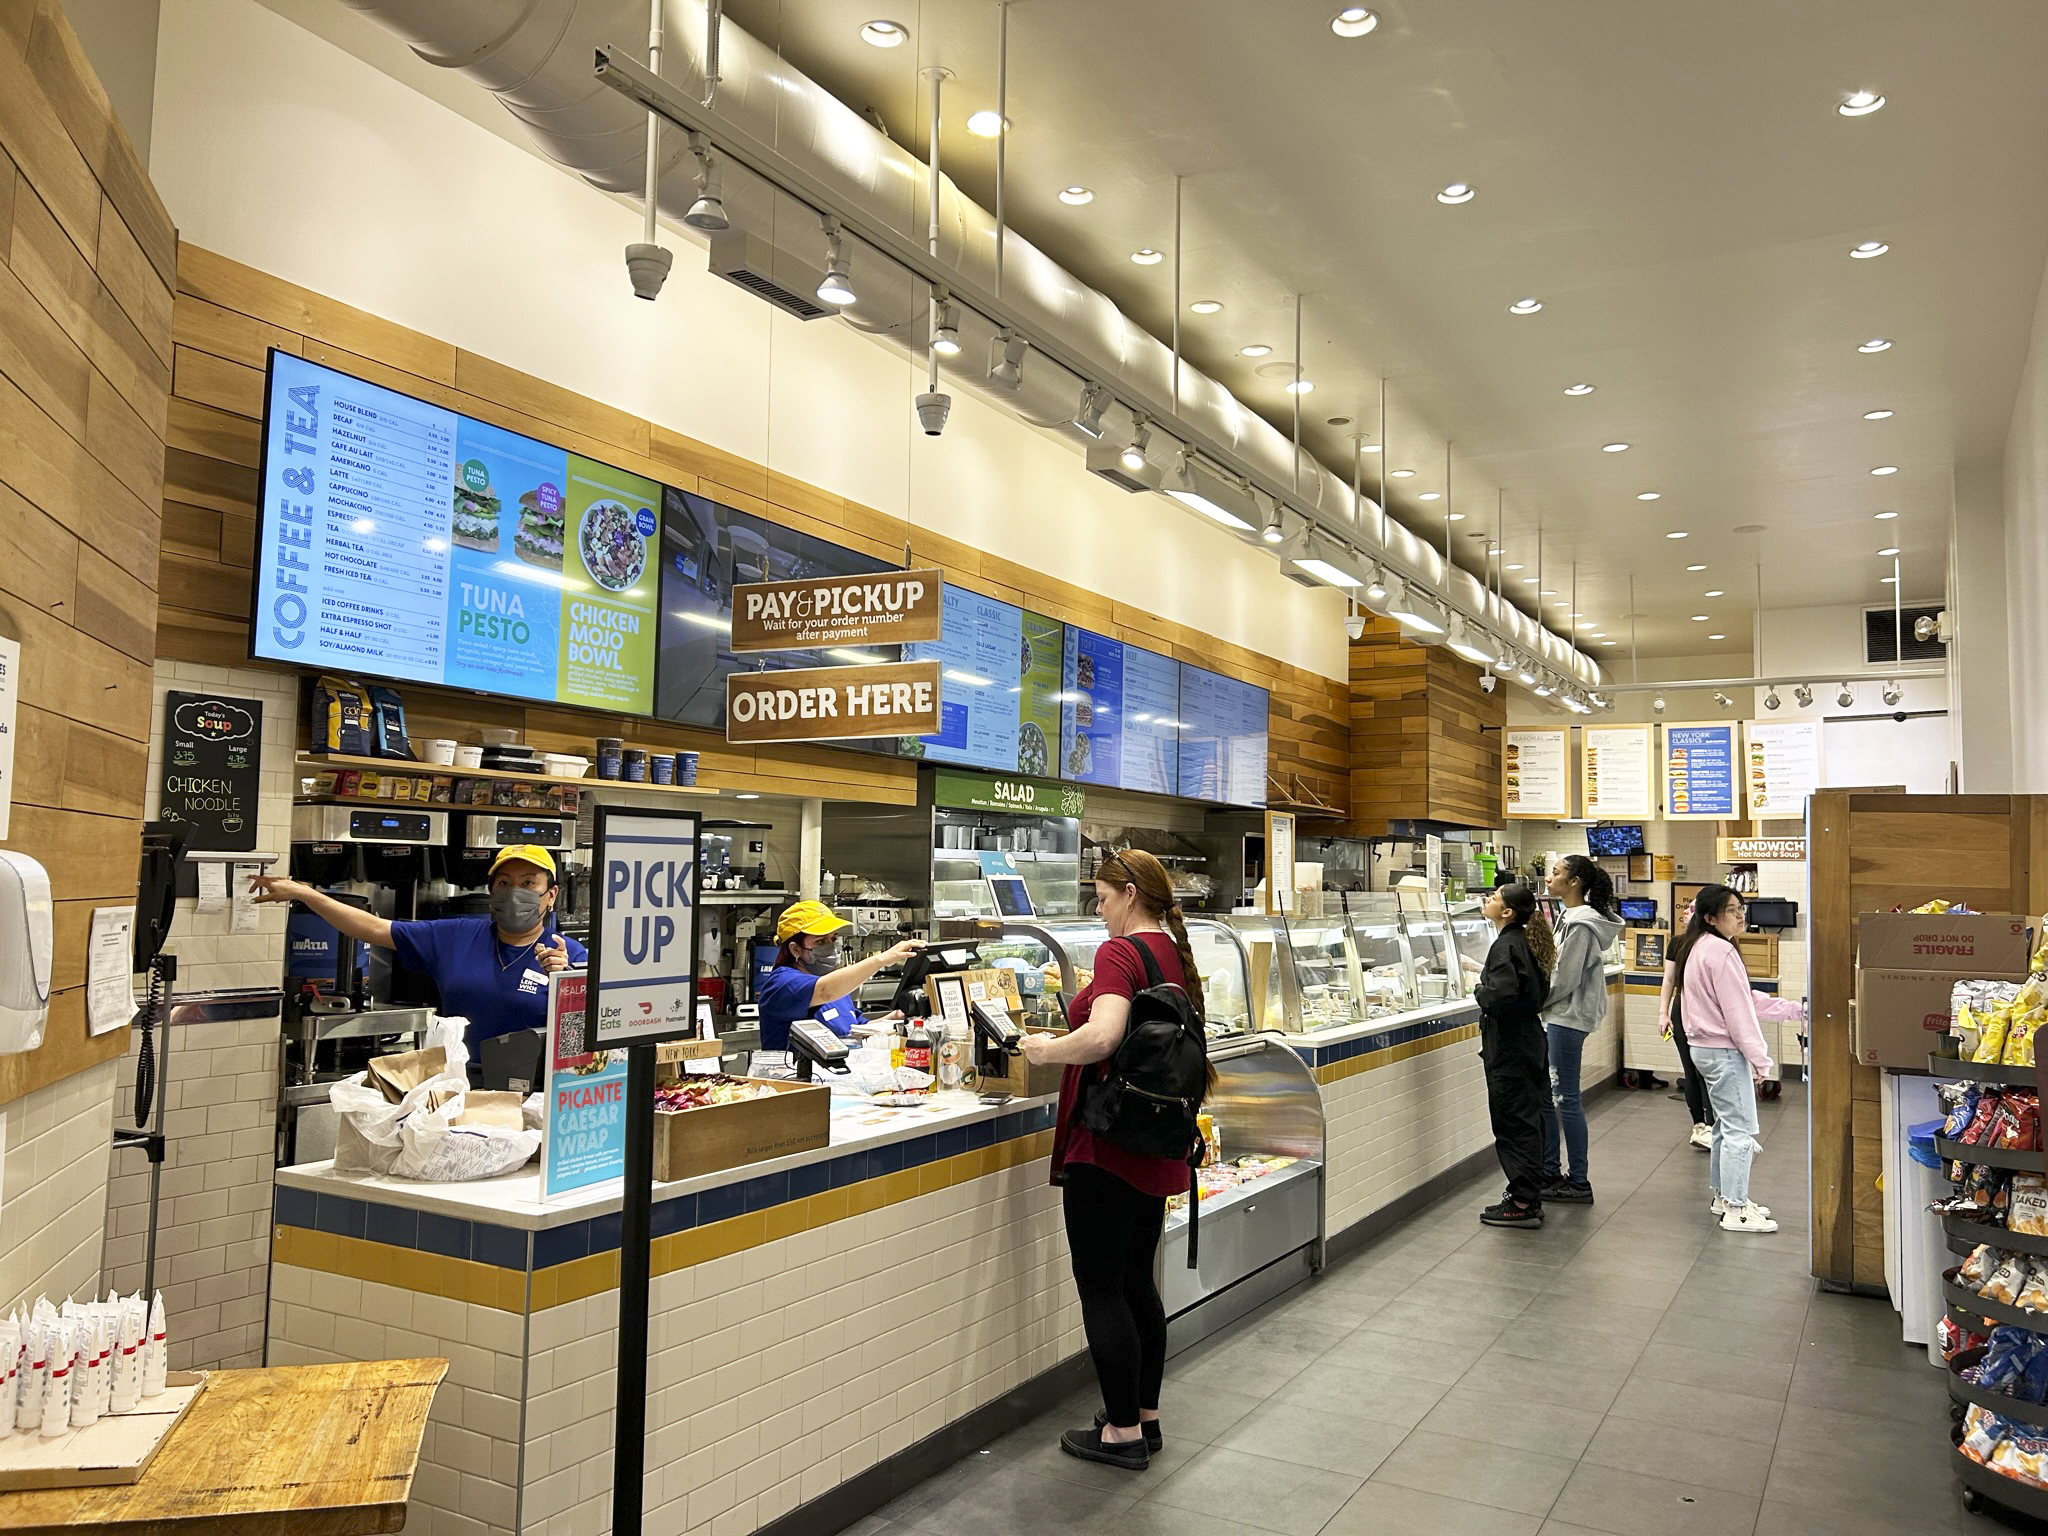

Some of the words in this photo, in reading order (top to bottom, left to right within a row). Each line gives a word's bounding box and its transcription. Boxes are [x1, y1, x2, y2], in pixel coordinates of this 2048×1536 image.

[333, 400, 356, 413] HOUSE
[357, 408, 377, 419] BLEND
[284, 385, 320, 455] TEA
[333, 413, 353, 424] DECAF
[332, 427, 366, 443] HAZELNUT
[331, 441, 347, 451] CAFE
[348, 446, 358, 454] AU
[360, 449, 373, 458] LAIT
[330, 455, 370, 472] AMERICANO
[467, 466, 485, 478] TUNA
[282, 466, 315, 495] &
[329, 468, 349, 479] LATTE
[466, 474, 486, 486] PESTO
[329, 482, 369, 498] CAPPUCCINO
[541, 486, 557, 496] SPICY
[541, 493, 557, 503] TUNA
[328, 496, 372, 513] MOCHACCINO
[540, 500, 557, 511] PESTO
[327, 509, 359, 523] ESPRESSO
[638, 514, 654, 524] GRAIN
[326, 523, 339, 532] TEA
[638, 521, 654, 531] BOWL
[325, 537, 351, 549] HERBAL
[352, 543, 364, 552] TEA
[324, 551, 340, 560] HOT
[340, 554, 377, 569] CHOCOLATE
[273, 499, 313, 649] COFFEE
[324, 564, 344, 575] FRESH
[345, 569, 359, 578] ICED
[360, 572, 372, 581] TEA
[321, 597, 336, 606] ICED
[336, 600, 360, 611] COFFEE
[361, 605, 384, 616] DRINKS
[460, 582, 525, 619] TUNA
[747, 591, 796, 620] PAY
[796, 590, 814, 617] &
[814, 581, 924, 616] PICKUP
[321, 611, 342, 622] EXTRA
[342, 616, 374, 627] ESPRESSO
[375, 621, 392, 631] SHOT
[570, 602, 639, 635] CHICKEN
[763, 618, 786, 631] Wait
[788, 618, 802, 629] for
[804, 618, 829, 631] your
[830, 614, 860, 627] order
[861, 612, 904, 625] number
[976, 605, 1001, 622] CLASSIC
[320, 626, 338, 635] HALF
[344, 630, 362, 639] HALF
[459, 609, 530, 644] PESTO
[796, 628, 820, 641] after
[822, 627, 868, 642] payment
[569, 622, 624, 651] MOJO
[319, 640, 365, 654] SOY/ALMOND
[366, 648, 384, 657] MILK
[568, 642, 623, 671] BOWL
[1062, 626, 1076, 751] SANWICH
[732, 687, 838, 723] ORDER
[846, 681, 933, 717] HERE
[204, 710, 226, 719] Today's
[196, 716, 232, 733] Soup
[175, 740, 194, 749] Small
[228, 744, 248, 754] Large
[167, 775, 232, 795] CHICKEN
[994, 780, 1035, 803] SALAD
[184, 797, 241, 811] NOODLE
[1732, 841, 1805, 852] SANDWICH
[1780, 851, 1800, 859] Soup
[607, 860, 693, 910] PICK
[292, 938, 329, 950] LAVAZZA
[623, 915, 675, 965] UP
[1912, 934, 1938, 942] DROP
[1962, 935, 1975, 943] DO
[1912, 944, 1975, 956] FRAGILE
[1880, 974, 1924, 982] VENDING
[519, 983, 537, 992] WICH
[600, 1006, 622, 1018] Uber
[600, 1018, 621, 1030] Eats
[628, 1017, 662, 1027] DOORDASH
[665, 1047, 680, 1061] NEW
[682, 1044, 699, 1059] YORK!
[557, 1081, 622, 1113] PICANTE
[557, 1103, 619, 1135] CAESAR
[557, 1127, 609, 1158] WRAP
